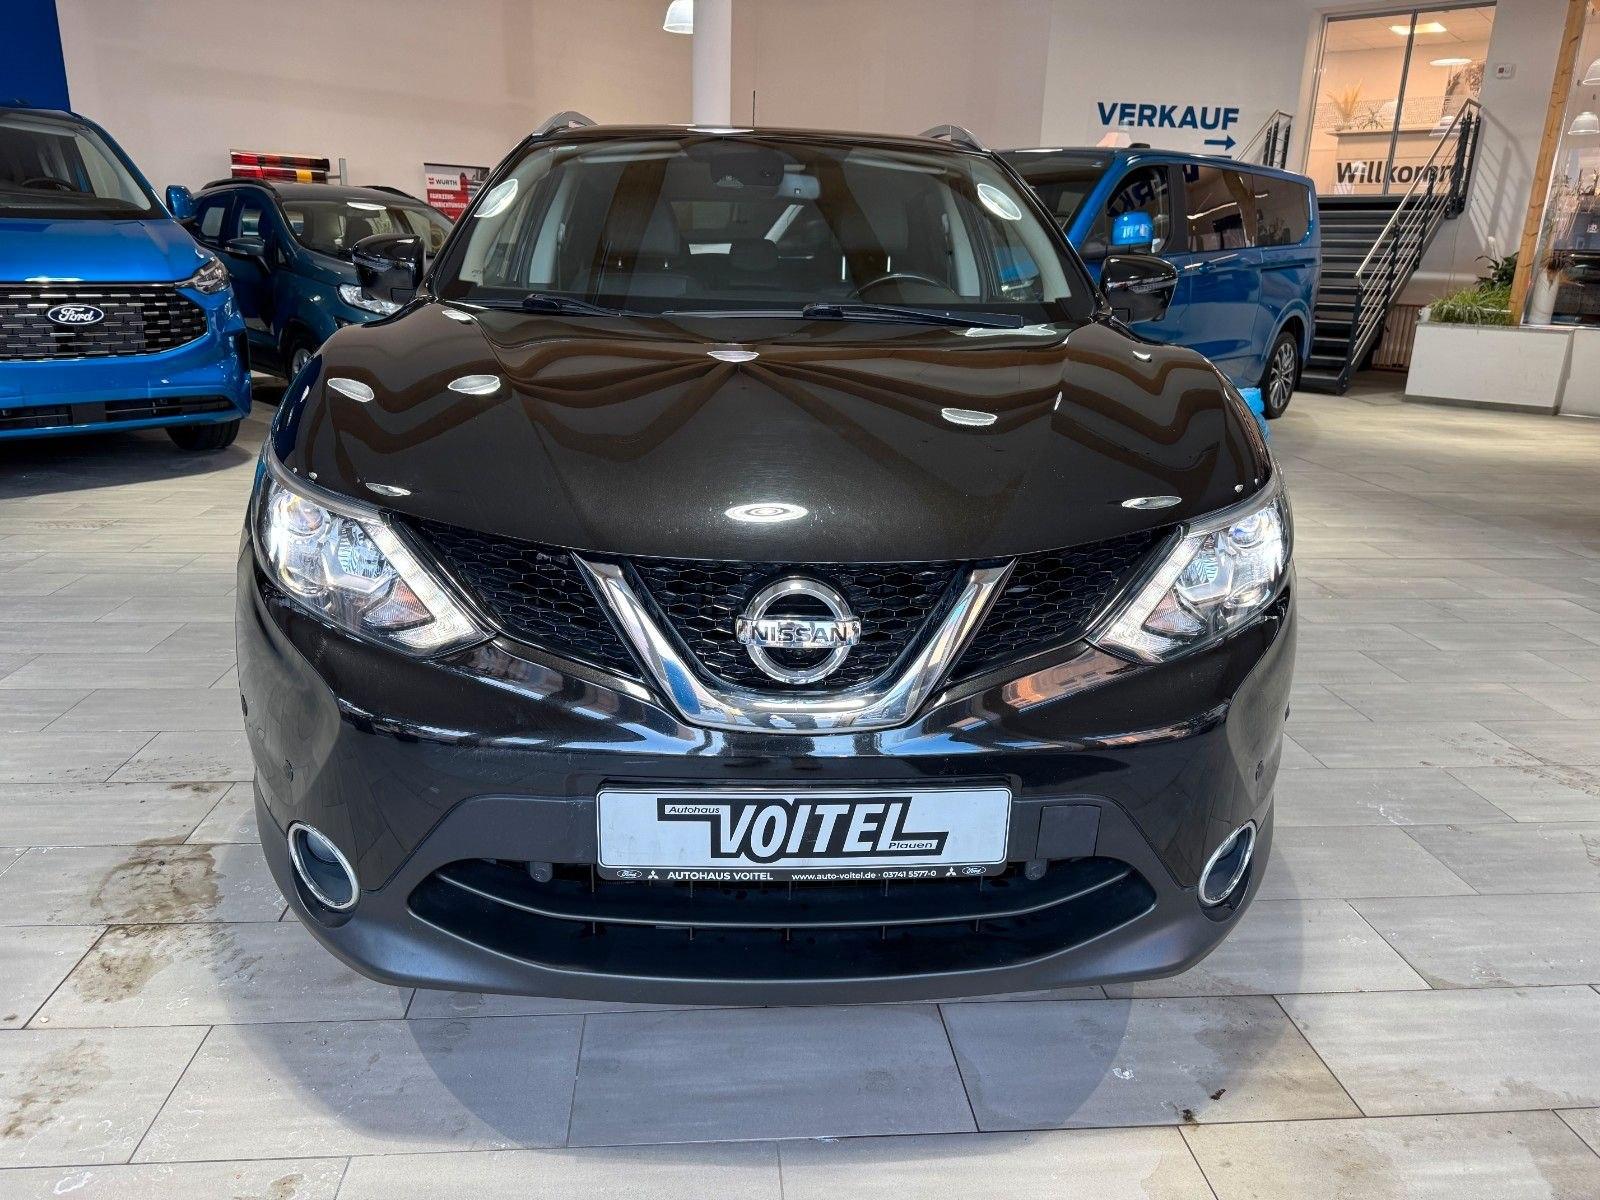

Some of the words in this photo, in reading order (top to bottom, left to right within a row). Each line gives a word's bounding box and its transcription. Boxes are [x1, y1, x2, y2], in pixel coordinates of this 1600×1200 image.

[1097, 102, 1239, 130] VERKAUF
[58, 307, 94, 321] Ford
[751, 626, 847, 642] NISSAN
[668, 805, 721, 814] Autohaus
[719, 803, 905, 858] VOITEL
[888, 841, 933, 849] Plauen
[667, 871, 731, 880] AUTOHAUS
[733, 872, 774, 880] VOITEL
[791, 872, 876, 880] www.auto-voitel.de
[882, 871, 906, 879] 03741
[908, 870, 937, 878] 5577-0
